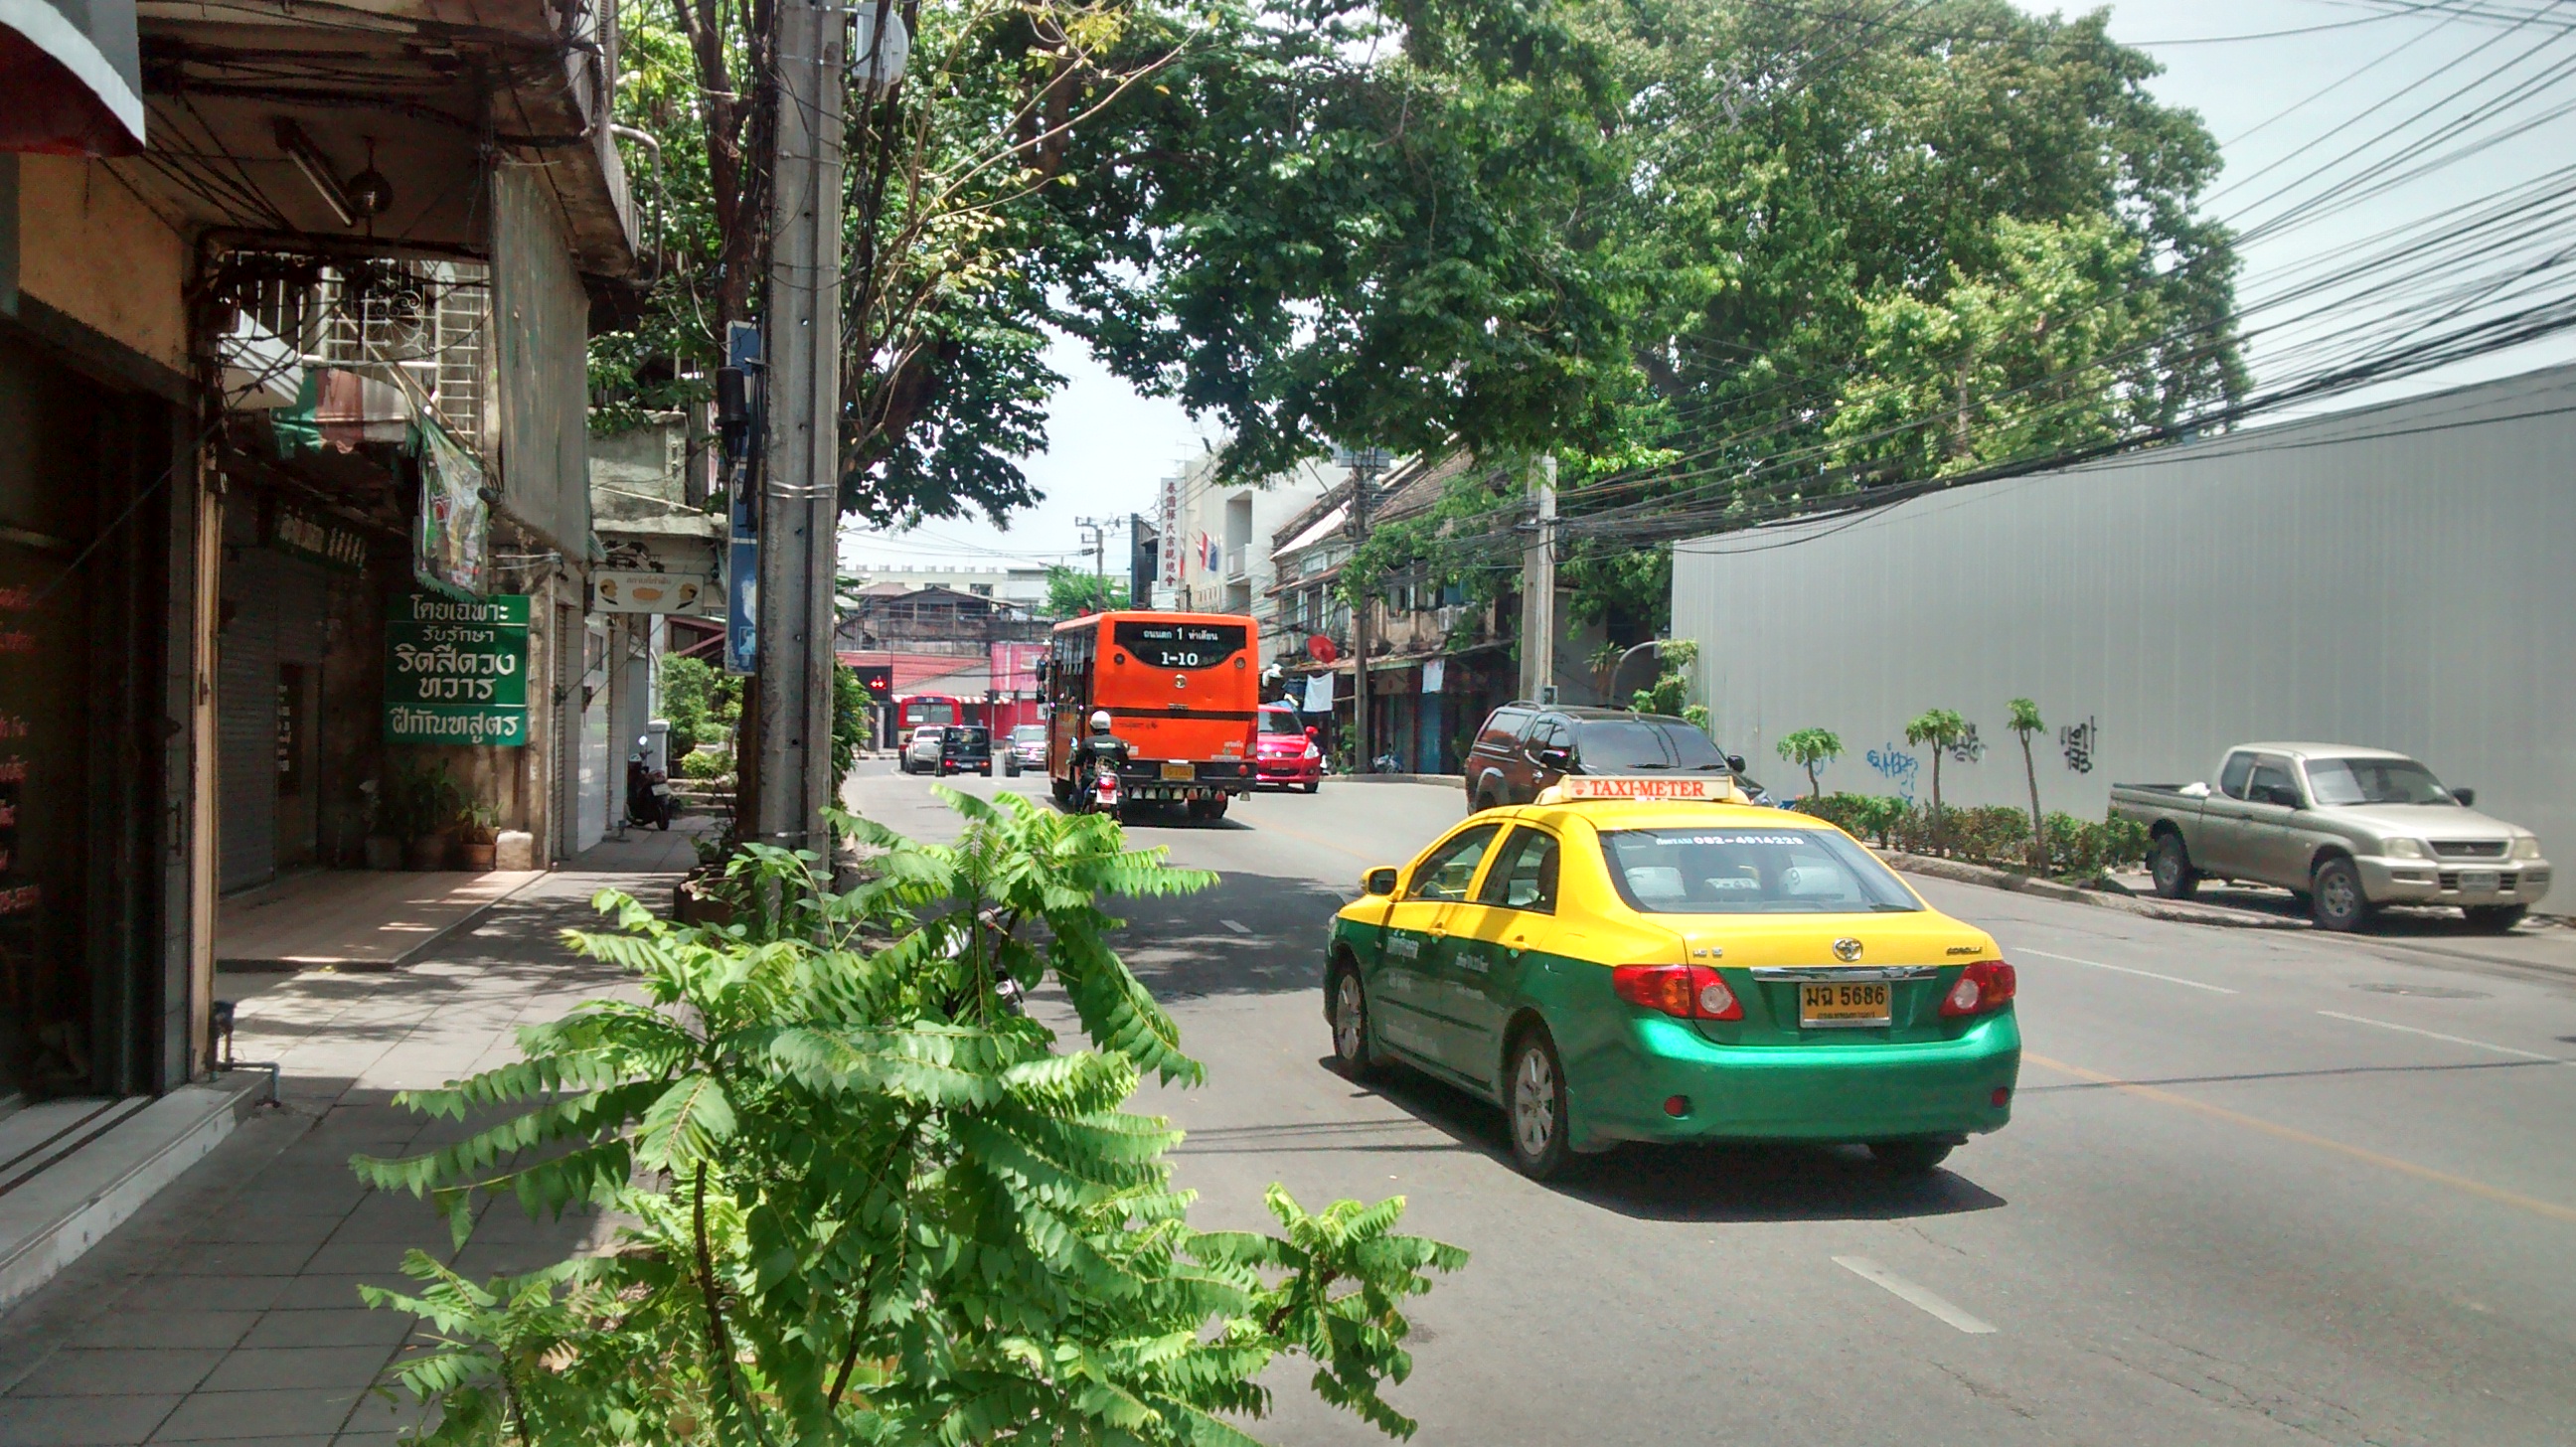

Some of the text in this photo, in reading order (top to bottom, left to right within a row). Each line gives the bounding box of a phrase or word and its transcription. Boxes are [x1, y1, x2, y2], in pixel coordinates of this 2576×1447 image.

[409, 594, 509, 621] โดยเฉพาะ
[422, 624, 495, 642] รับรักษา
[1177, 626, 1183, 640] 1
[395, 643, 516, 676] ริดสีดวง
[1161, 651, 1199, 666] 1-10
[418, 677, 497, 700] ทวาร
[1589, 779, 1705, 797] TAXI-METER
[1841, 985, 1885, 1006] 5686
